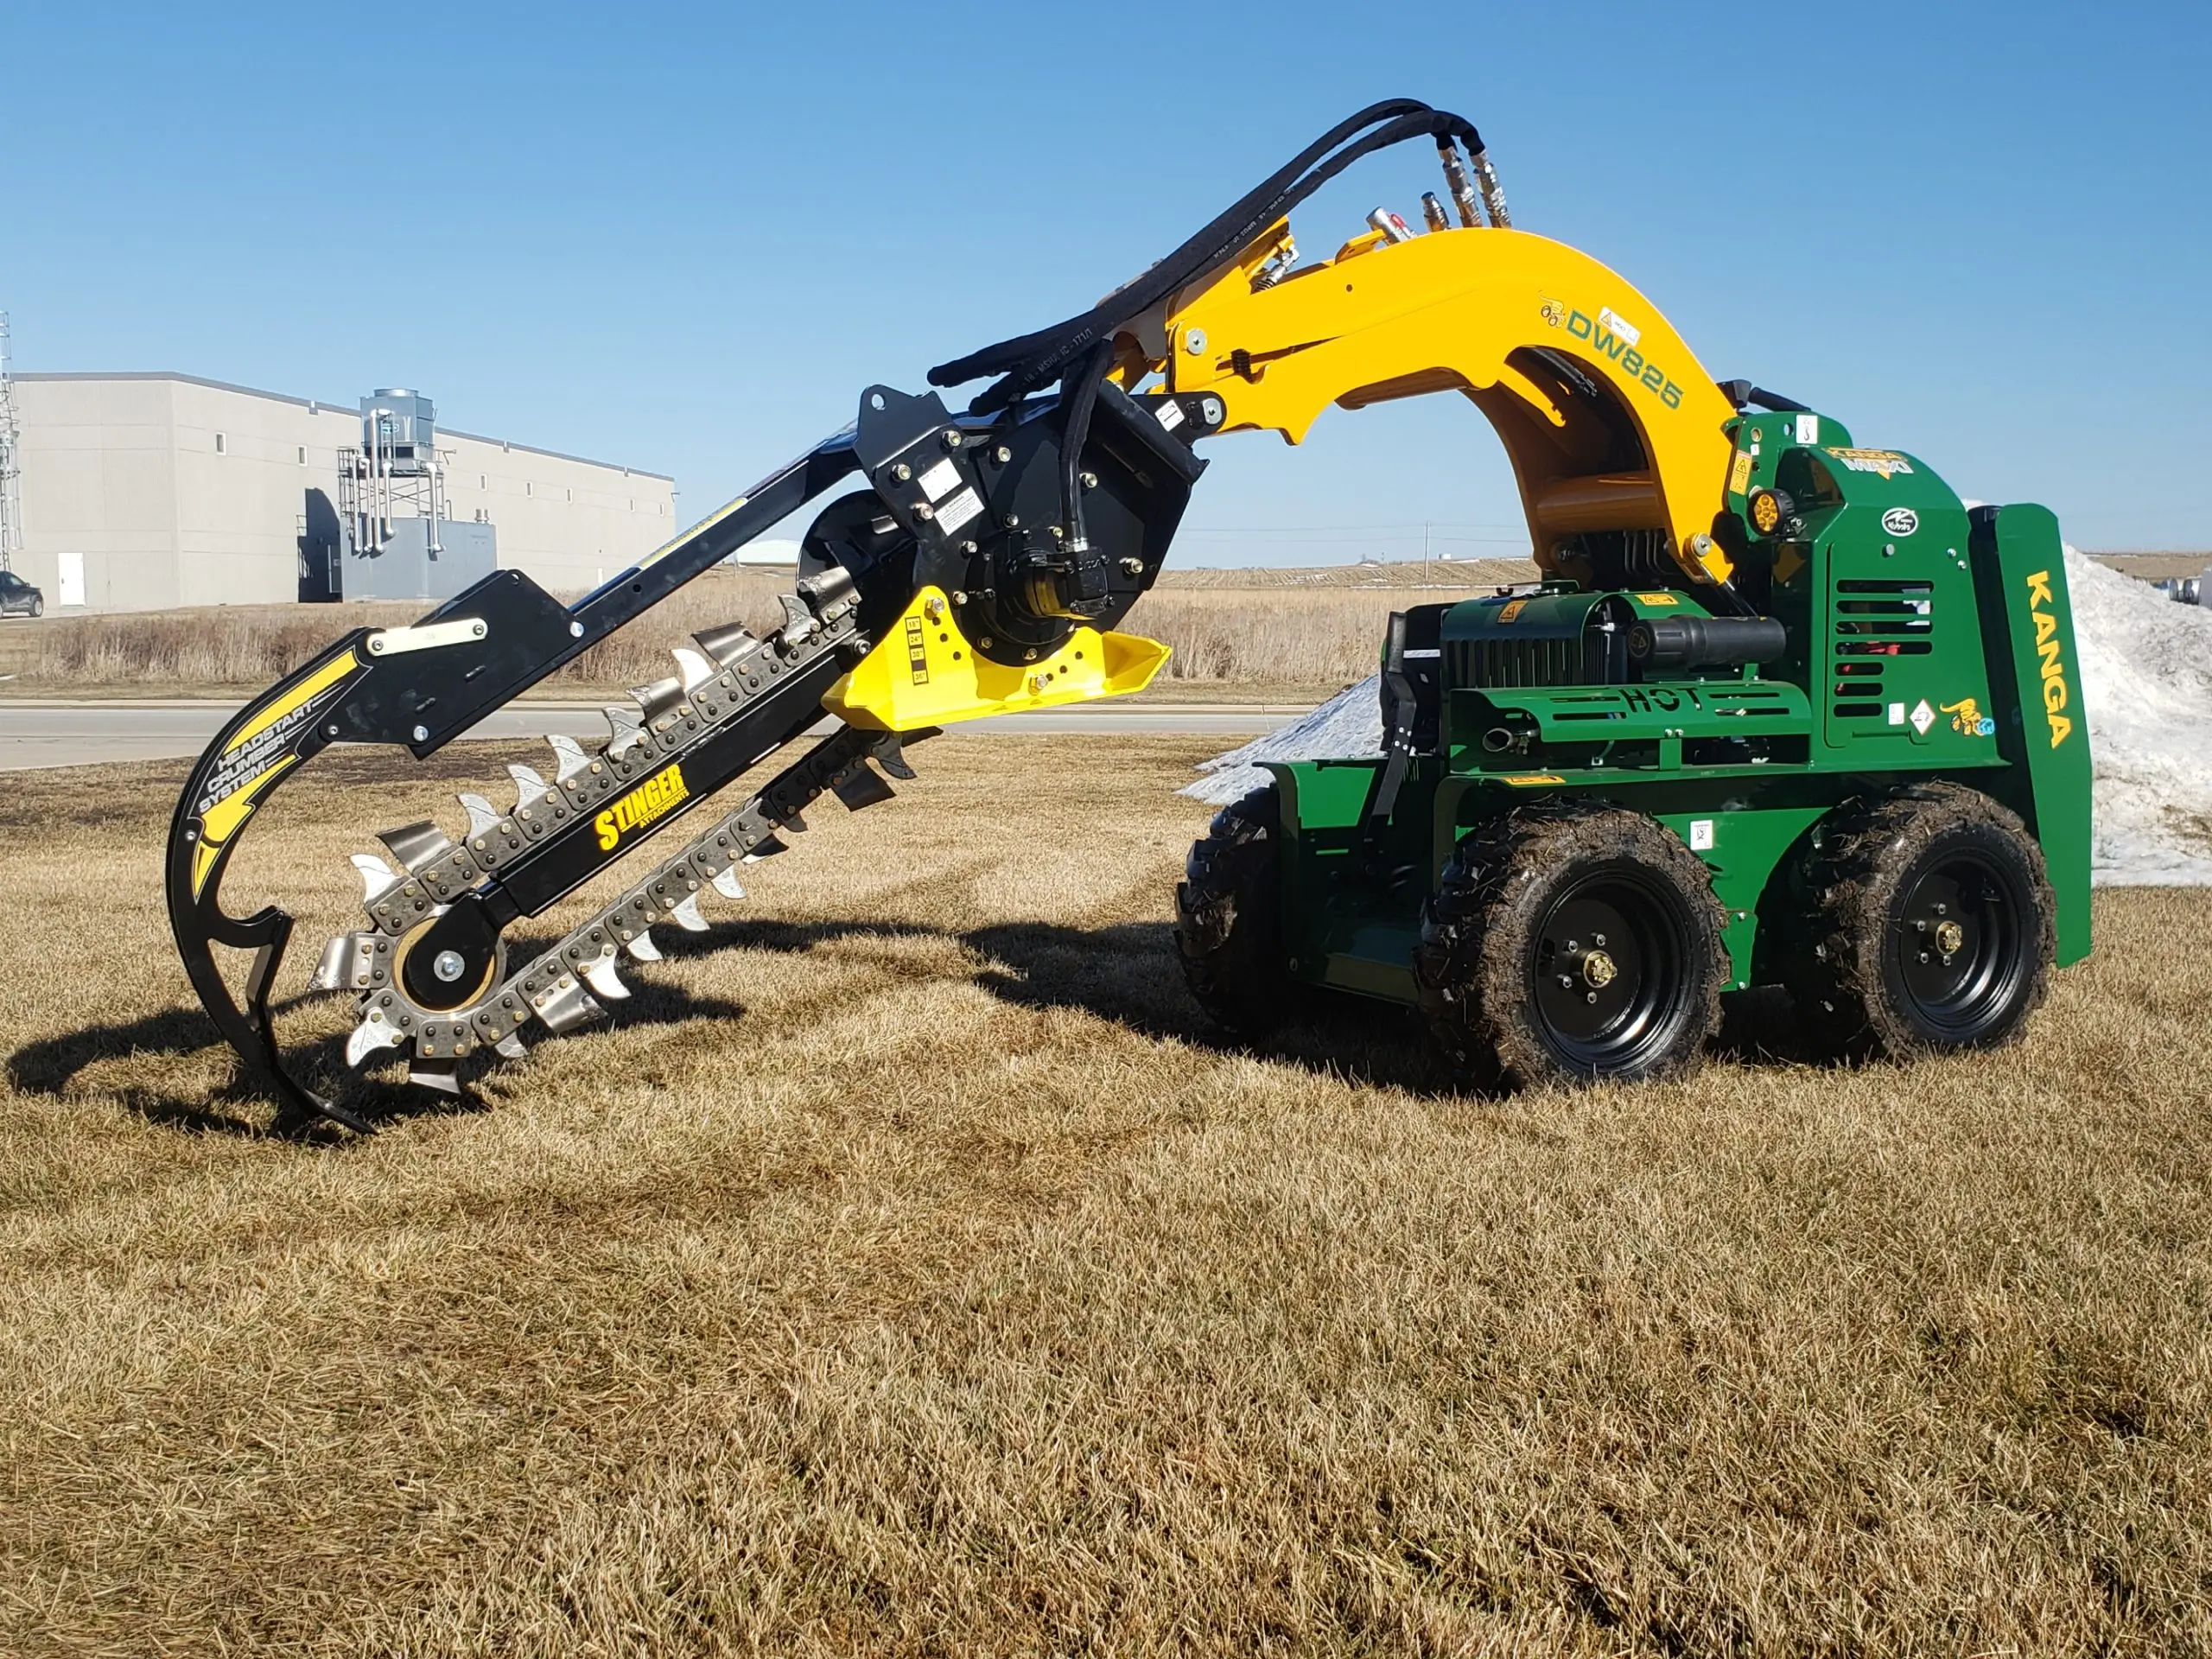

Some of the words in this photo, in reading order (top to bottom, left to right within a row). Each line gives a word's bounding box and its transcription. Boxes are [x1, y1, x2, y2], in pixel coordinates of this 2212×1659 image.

[1567, 309, 1684, 410] DW825
[2026, 570, 2072, 750] KANGA
[1618, 688, 1702, 713] HOT
[207, 733, 286, 793] CRUMBER
[218, 700, 313, 772] HEADSTART
[199, 760, 266, 813] SYSTEM
[595, 764, 684, 850] STINGER
[640, 788, 690, 829] ATTACHMENTS
